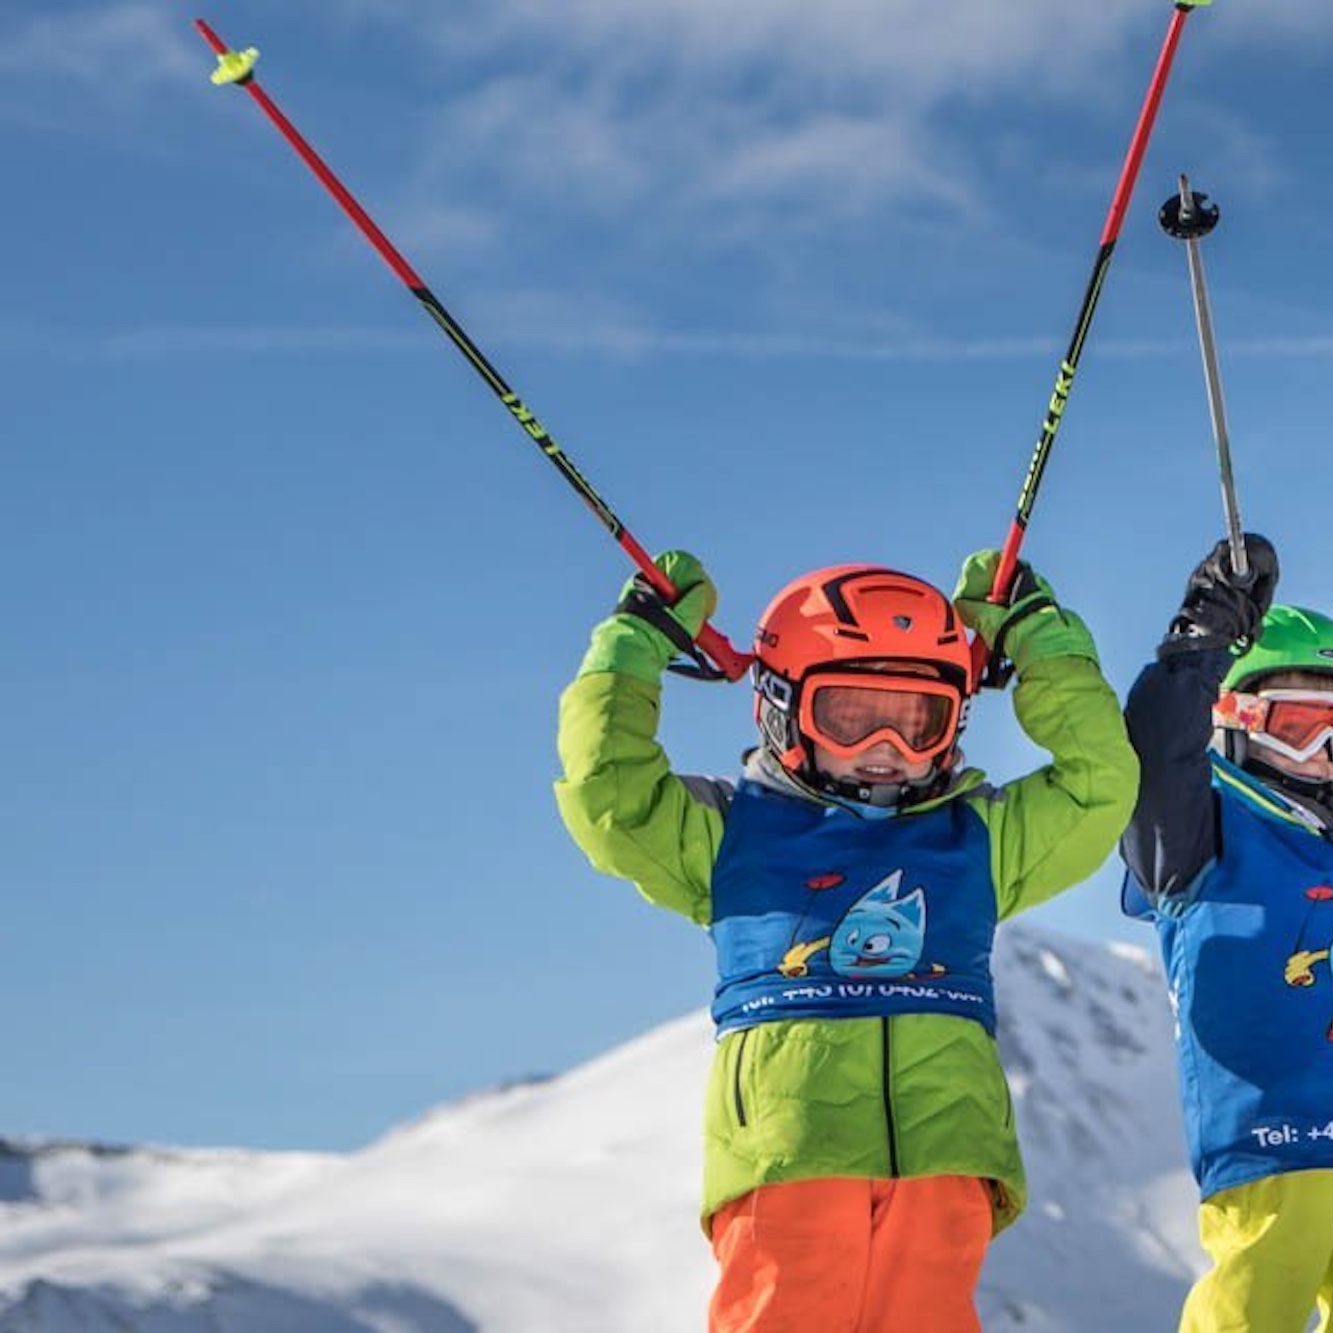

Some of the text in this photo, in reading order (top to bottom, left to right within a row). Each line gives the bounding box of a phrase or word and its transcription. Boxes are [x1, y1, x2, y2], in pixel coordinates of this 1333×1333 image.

[502, 391, 560, 456] LEKI
[1042, 359, 1076, 435] LEKI
[1251, 1123, 1300, 1148] Tel:
